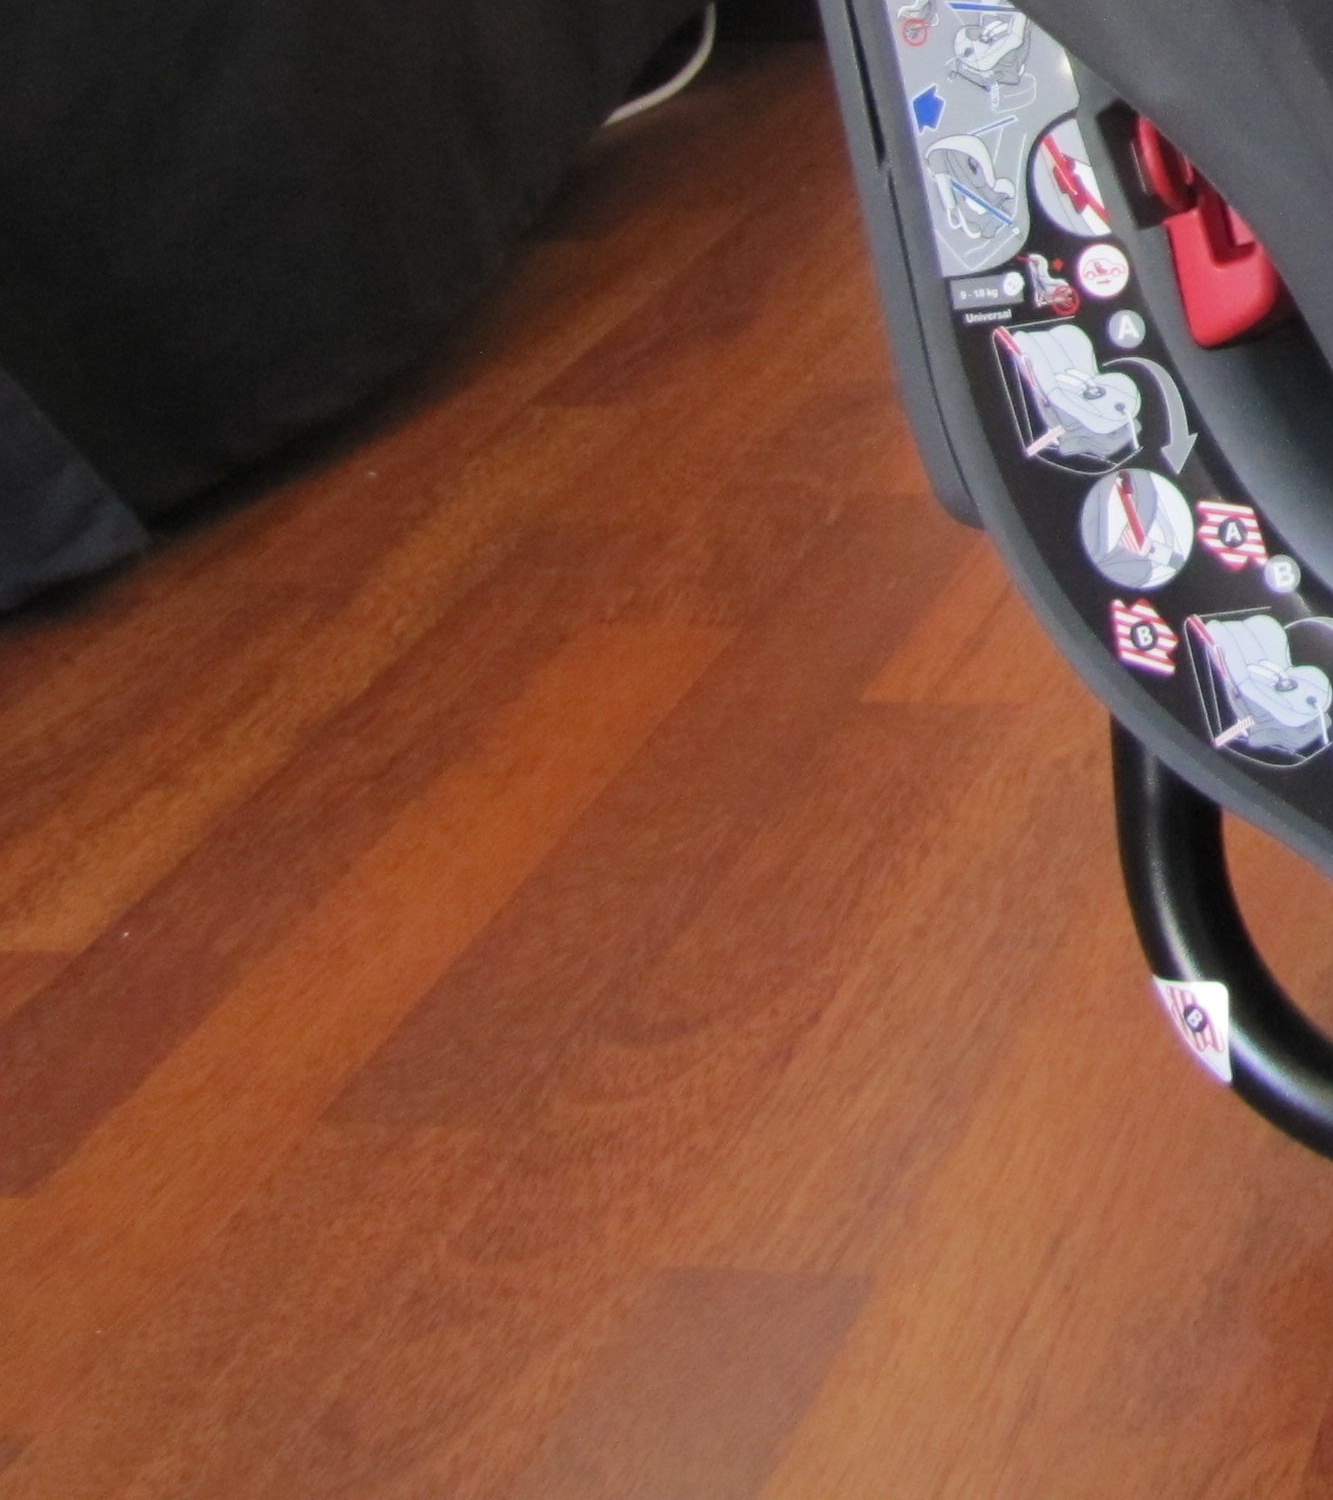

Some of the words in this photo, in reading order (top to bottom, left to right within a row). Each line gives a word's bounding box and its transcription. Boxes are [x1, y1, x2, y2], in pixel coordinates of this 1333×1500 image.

[965, 309, 1012, 324] Universal
[1118, 315, 1139, 340] A
[1225, 522, 1242, 543] A
[1273, 561, 1296, 589] B
[1136, 625, 1153, 647] B
[1187, 1008, 1203, 1028] B
